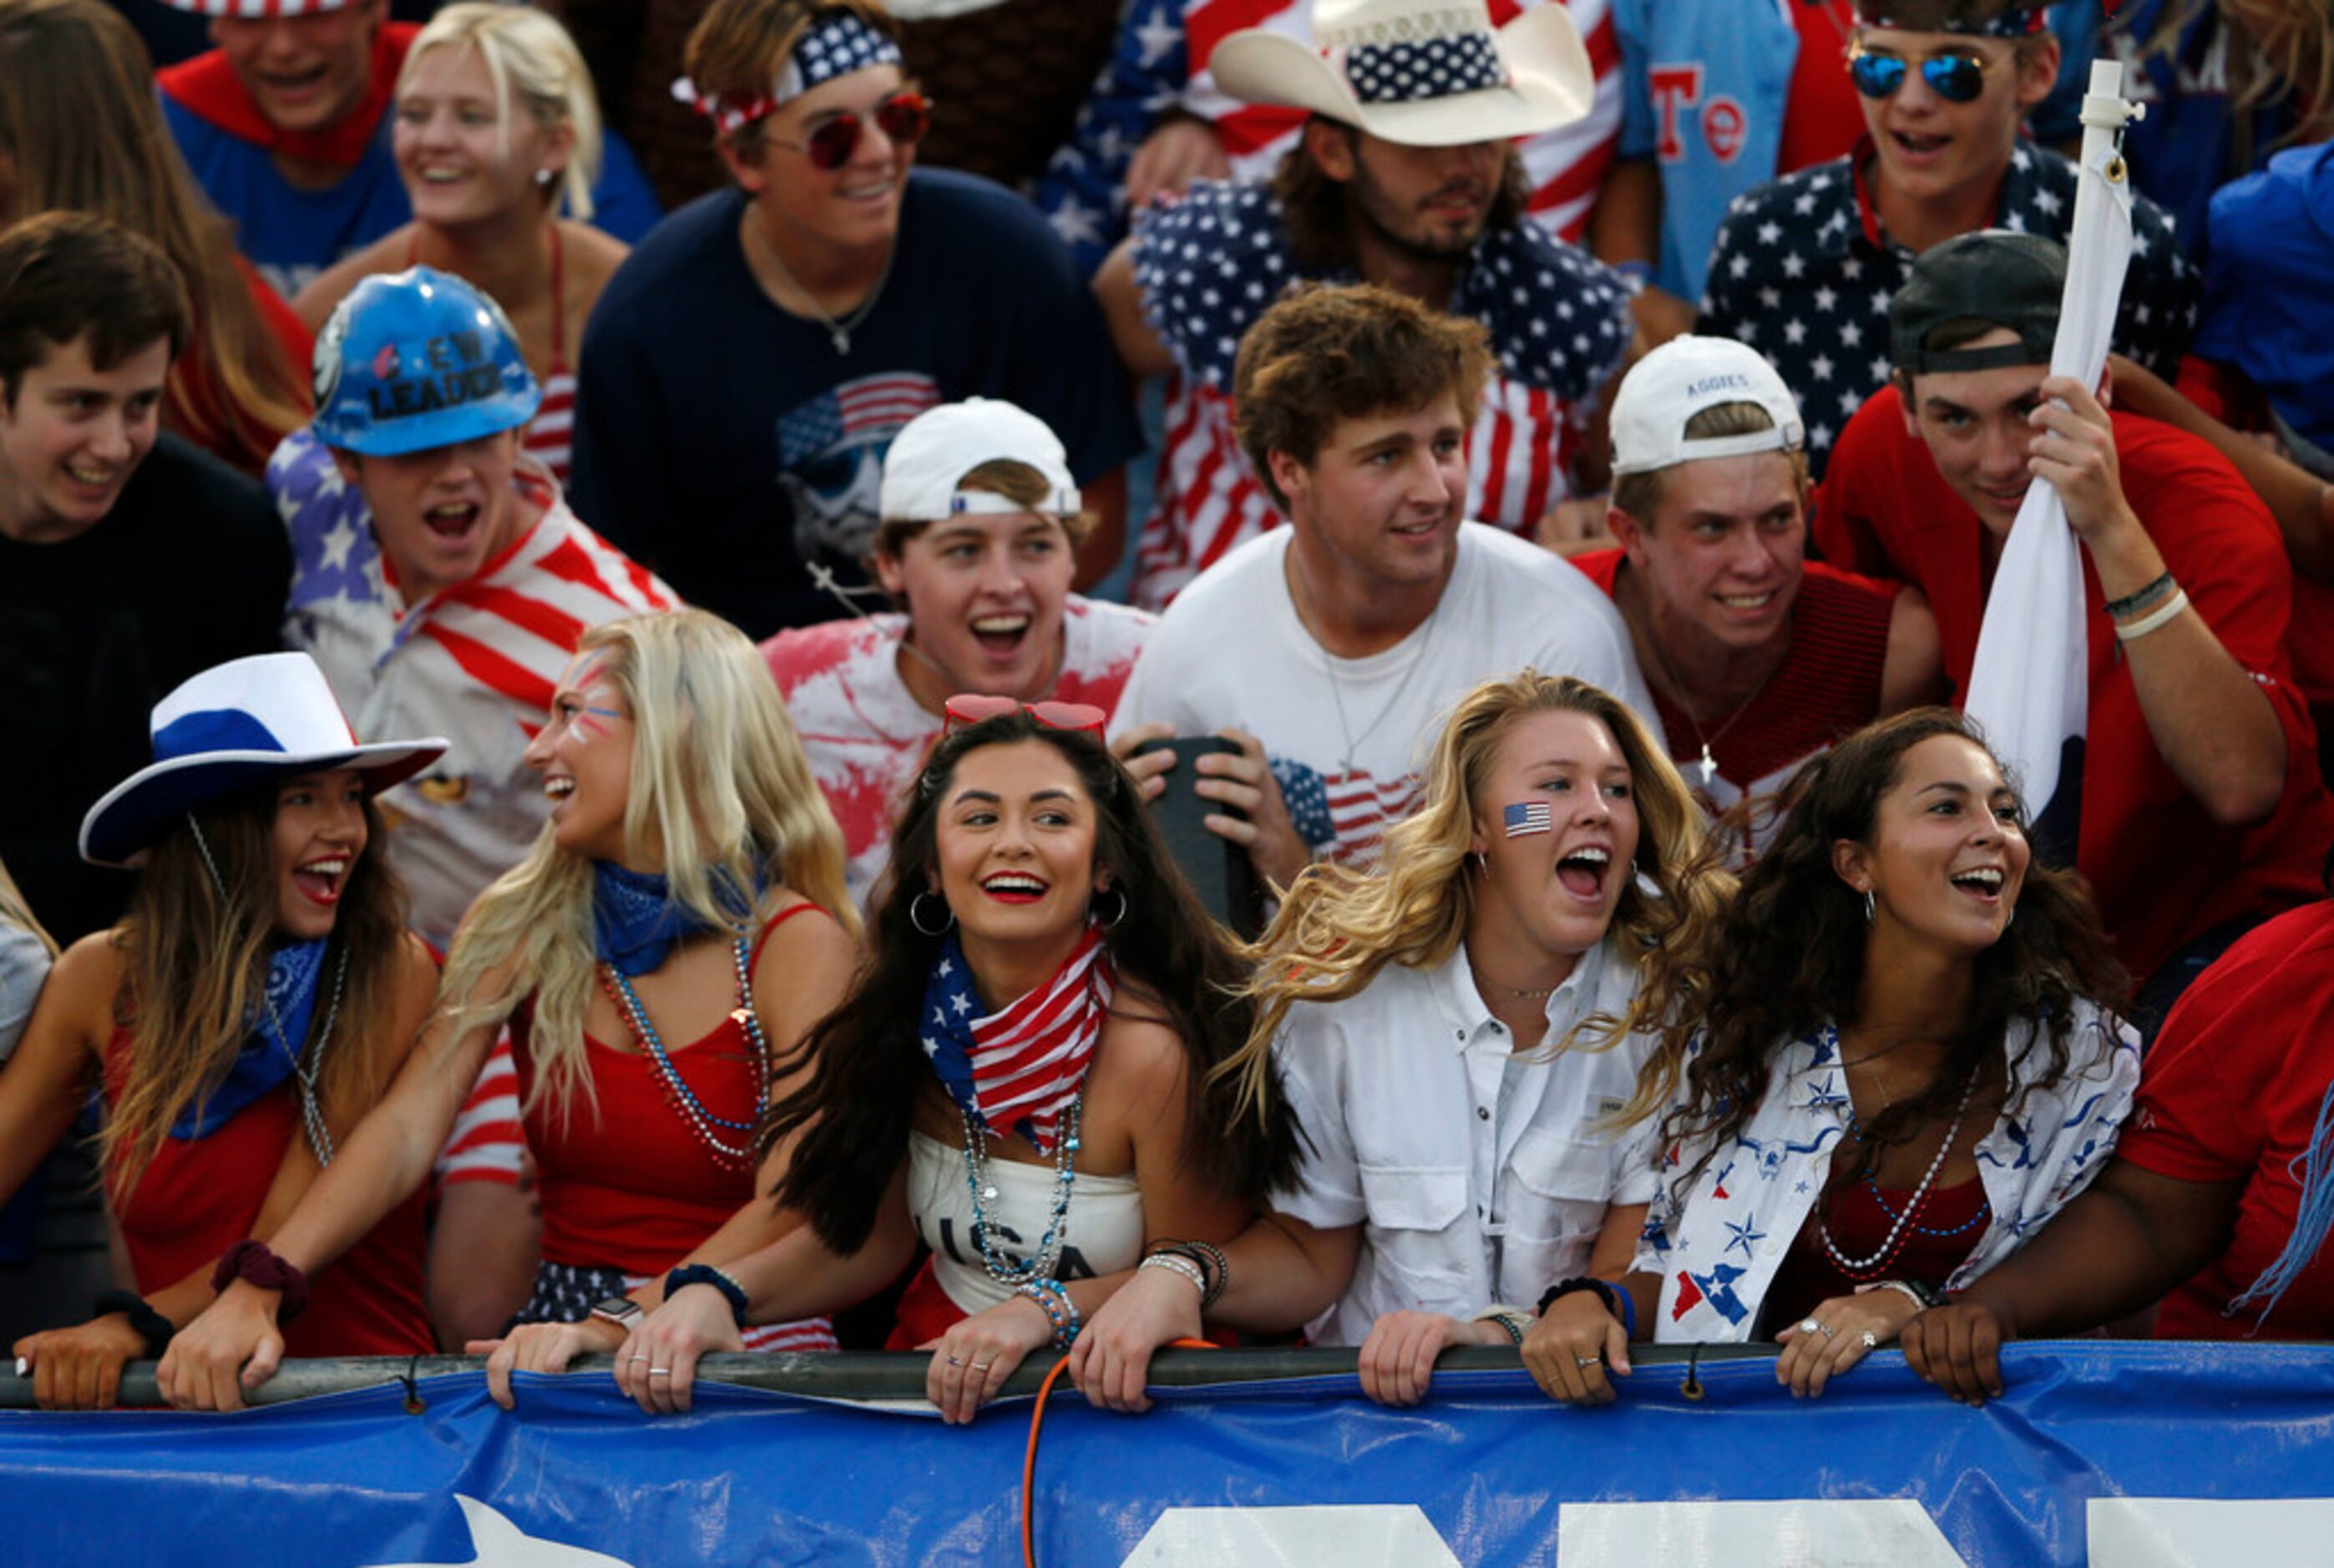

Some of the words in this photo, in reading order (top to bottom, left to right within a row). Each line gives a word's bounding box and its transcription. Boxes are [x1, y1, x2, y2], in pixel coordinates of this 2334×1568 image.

[1648, 61, 1750, 165] Te
[1687, 374, 1749, 397] AGGIES
[915, 1216, 1098, 1281] USA
